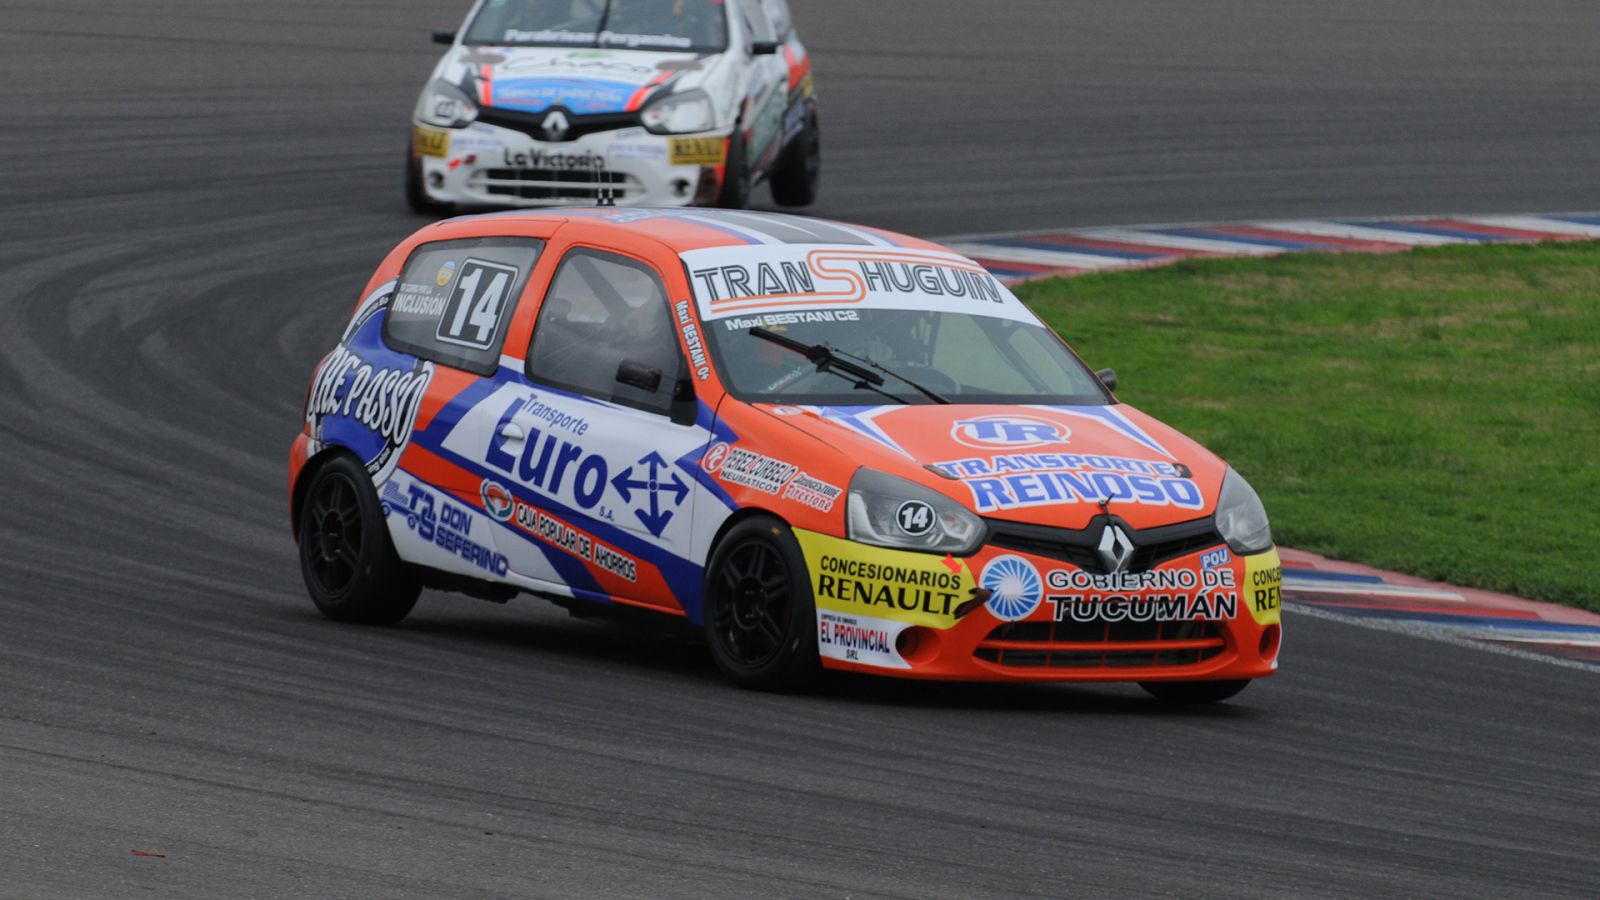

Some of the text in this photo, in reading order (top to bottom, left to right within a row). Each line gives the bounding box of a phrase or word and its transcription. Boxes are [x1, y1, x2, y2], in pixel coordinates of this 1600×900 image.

[504, 149, 524, 166] La
[529, 149, 605, 169] Victoria
[392, 293, 446, 316] INCLUSIÓN
[450, 269, 509, 342] 14
[725, 311, 860, 330] Maxi BESTANI C2
[675, 300, 691, 323] Maxi
[683, 325, 705, 367] BESTANI
[344, 363, 430, 445] PASSO
[521, 394, 589, 436] Transporte
[954, 420, 1068, 444] TR
[485, 398, 608, 510] Euro
[720, 470, 778, 494] NEUMATICOS
[968, 473, 1202, 508] REINOSO
[440, 502, 473, 536] DON
[902, 507, 929, 529] 14
[435, 525, 509, 578] SEFERINO
[517, 504, 636, 581] CAJA POPULAR DE AHORROS
[1203, 549, 1228, 567] POU
[820, 555, 961, 590] CONCESIONARIOS
[1047, 568, 1235, 591] GOBIERNO DE
[818, 574, 960, 616] RENAULT
[1047, 589, 1237, 622] TUCUMÁN
[820, 621, 890, 654] EL PROVINCIAL
[845, 648, 859, 660] SRL
